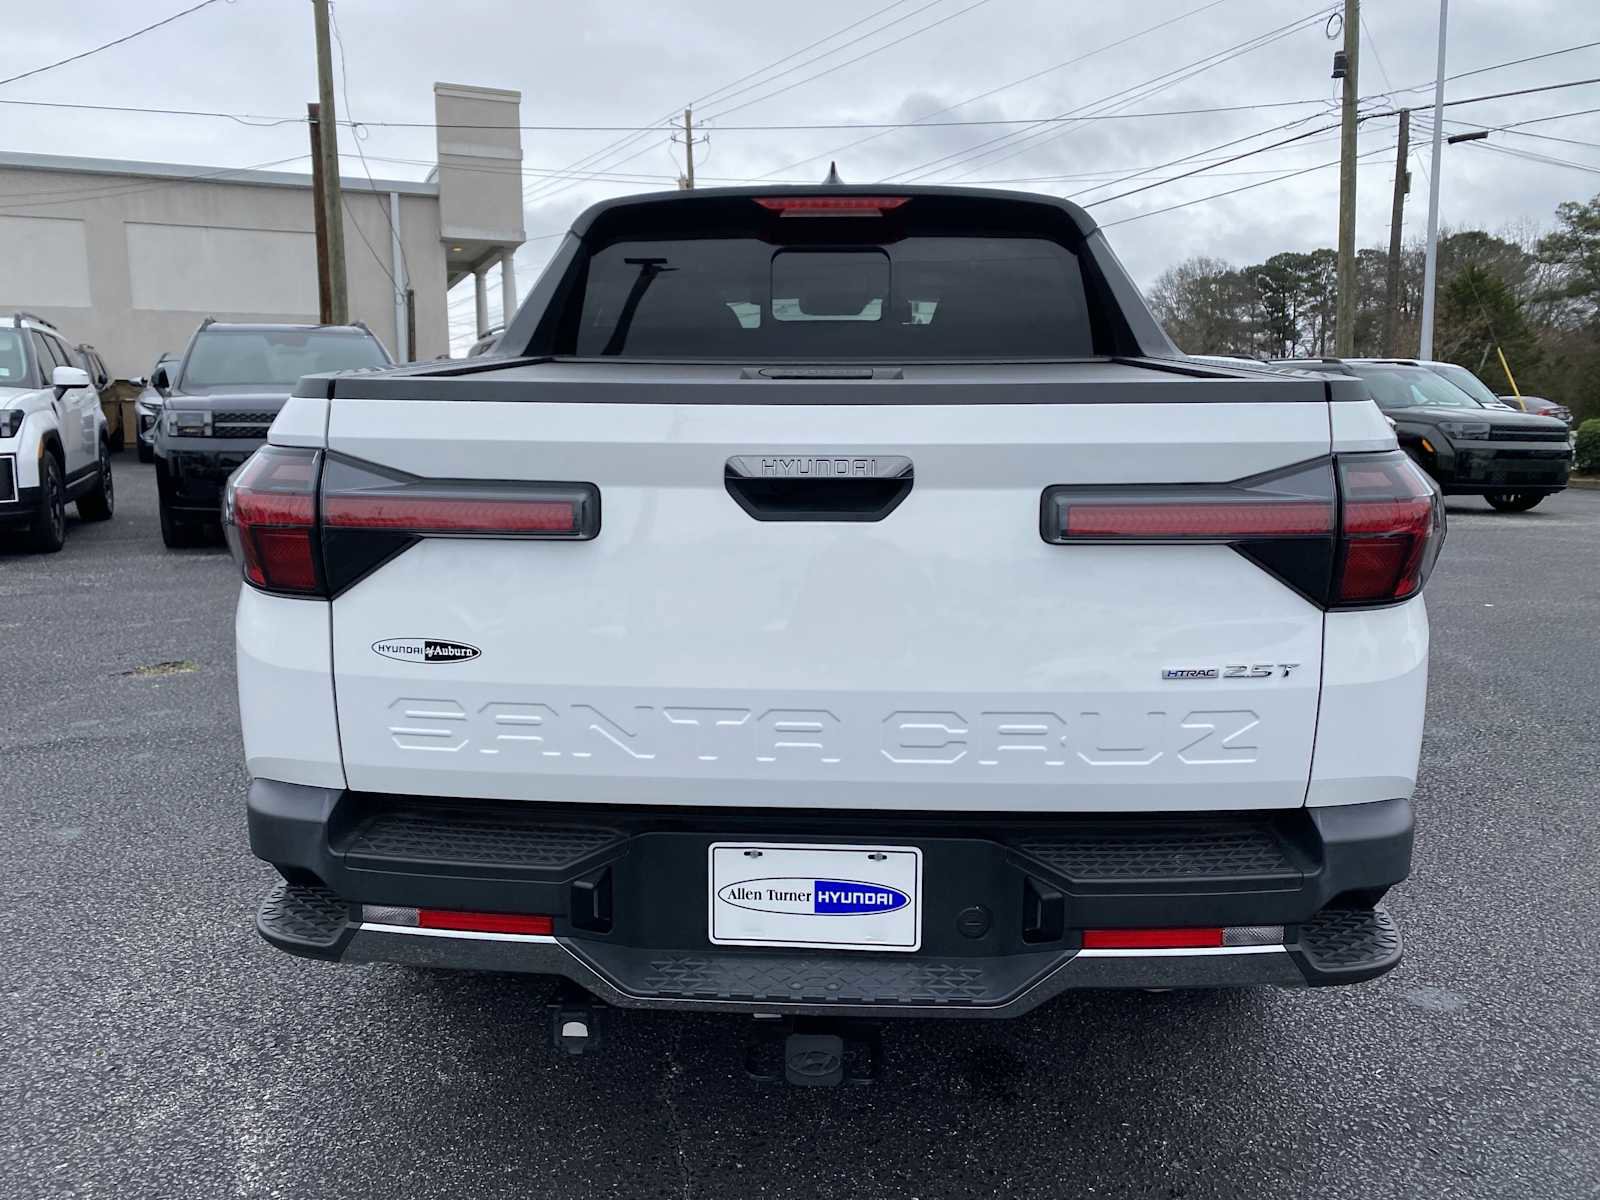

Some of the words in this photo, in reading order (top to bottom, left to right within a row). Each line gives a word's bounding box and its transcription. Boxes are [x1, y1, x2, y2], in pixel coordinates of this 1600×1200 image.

[761, 459, 876, 477] HYUNDAI
[378, 645, 423, 654] HYUNDAI
[434, 646, 473, 656] Auburn
[1167, 669, 1216, 678] HTRAC
[388, 697, 841, 763] SANTA
[880, 710, 1260, 766] CRUZ
[728, 888, 762, 901] Allen
[767, 889, 811, 902] Turner
[818, 891, 893, 905] HYUNDAI
